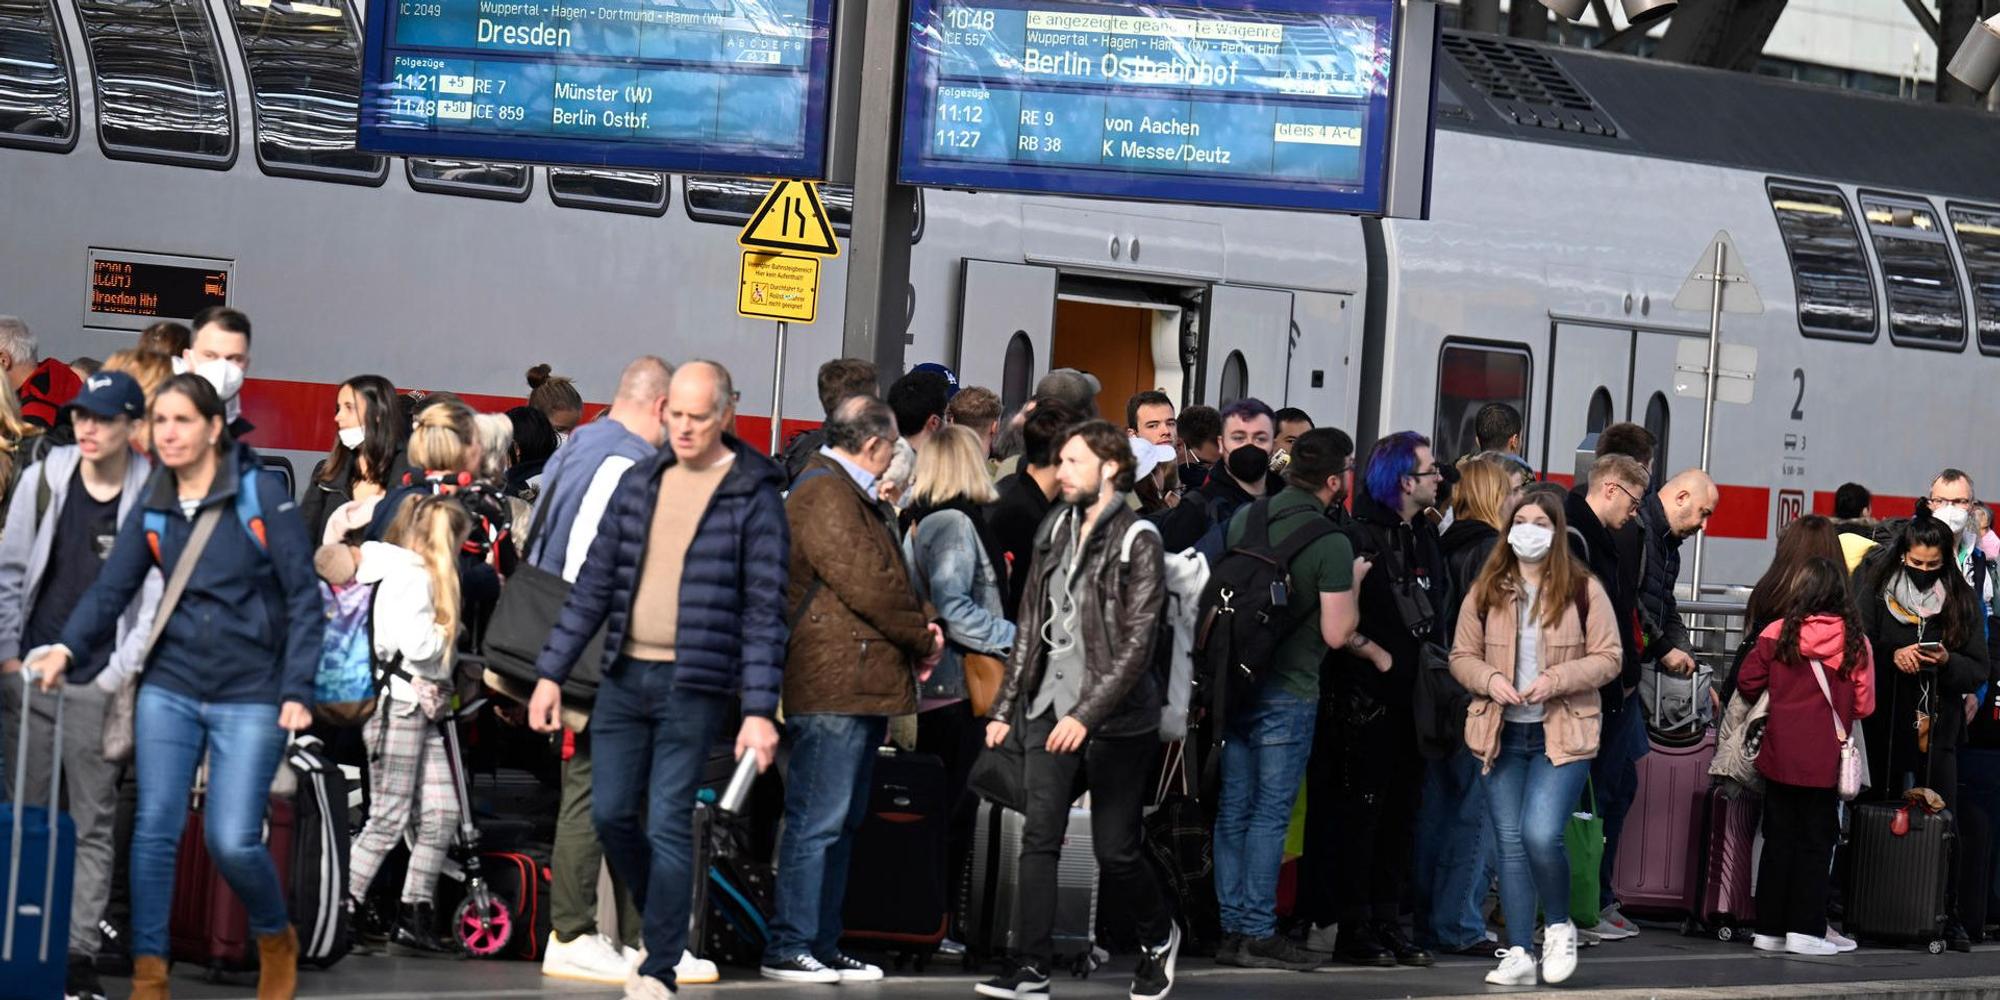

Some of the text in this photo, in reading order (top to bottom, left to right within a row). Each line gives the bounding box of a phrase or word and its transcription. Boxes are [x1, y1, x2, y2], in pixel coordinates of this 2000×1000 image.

[400, 4, 441, 17] IC 2049
[480, 1, 539, 16] Wuppertal
[552, 6, 586, 20] Hagen
[598, 8, 654, 22] Dortmund
[666, 12, 700, 24] Hamm
[703, 13, 723, 26] (W)
[948, 9, 995, 30] 10:48
[477, 18, 571, 47] Dresden
[1046, 14, 1129, 30] angezeigte
[944, 32, 986, 46] ICE 557
[1027, 31, 1088, 46] Wuppertal
[1101, 36, 1138, 51] Hagen
[394, 56, 445, 70] Folgezüge
[1024, 48, 1239, 86] Berlin Ostbahnhof
[395, 74, 436, 92] 11:21
[474, 79, 492, 94] RE
[498, 80, 506, 94] 7
[554, 82, 653, 104] Münster (W)
[938, 86, 990, 100] Folgezüge
[393, 99, 436, 116] 11:48
[472, 104, 494, 119] ICE
[499, 106, 525, 121] 859
[553, 108, 650, 129] Berlin Ostbf.
[939, 103, 1054, 126] 11:12 RE 9
[1105, 116, 1200, 136] von Aachen
[936, 129, 1062, 152] 11:27 RB 38
[1103, 140, 1232, 164] K Messe/Deutz
[1790, 367, 1806, 421] 2
[1801, 436, 1807, 451] 3
[1780, 497, 1801, 530] DB
